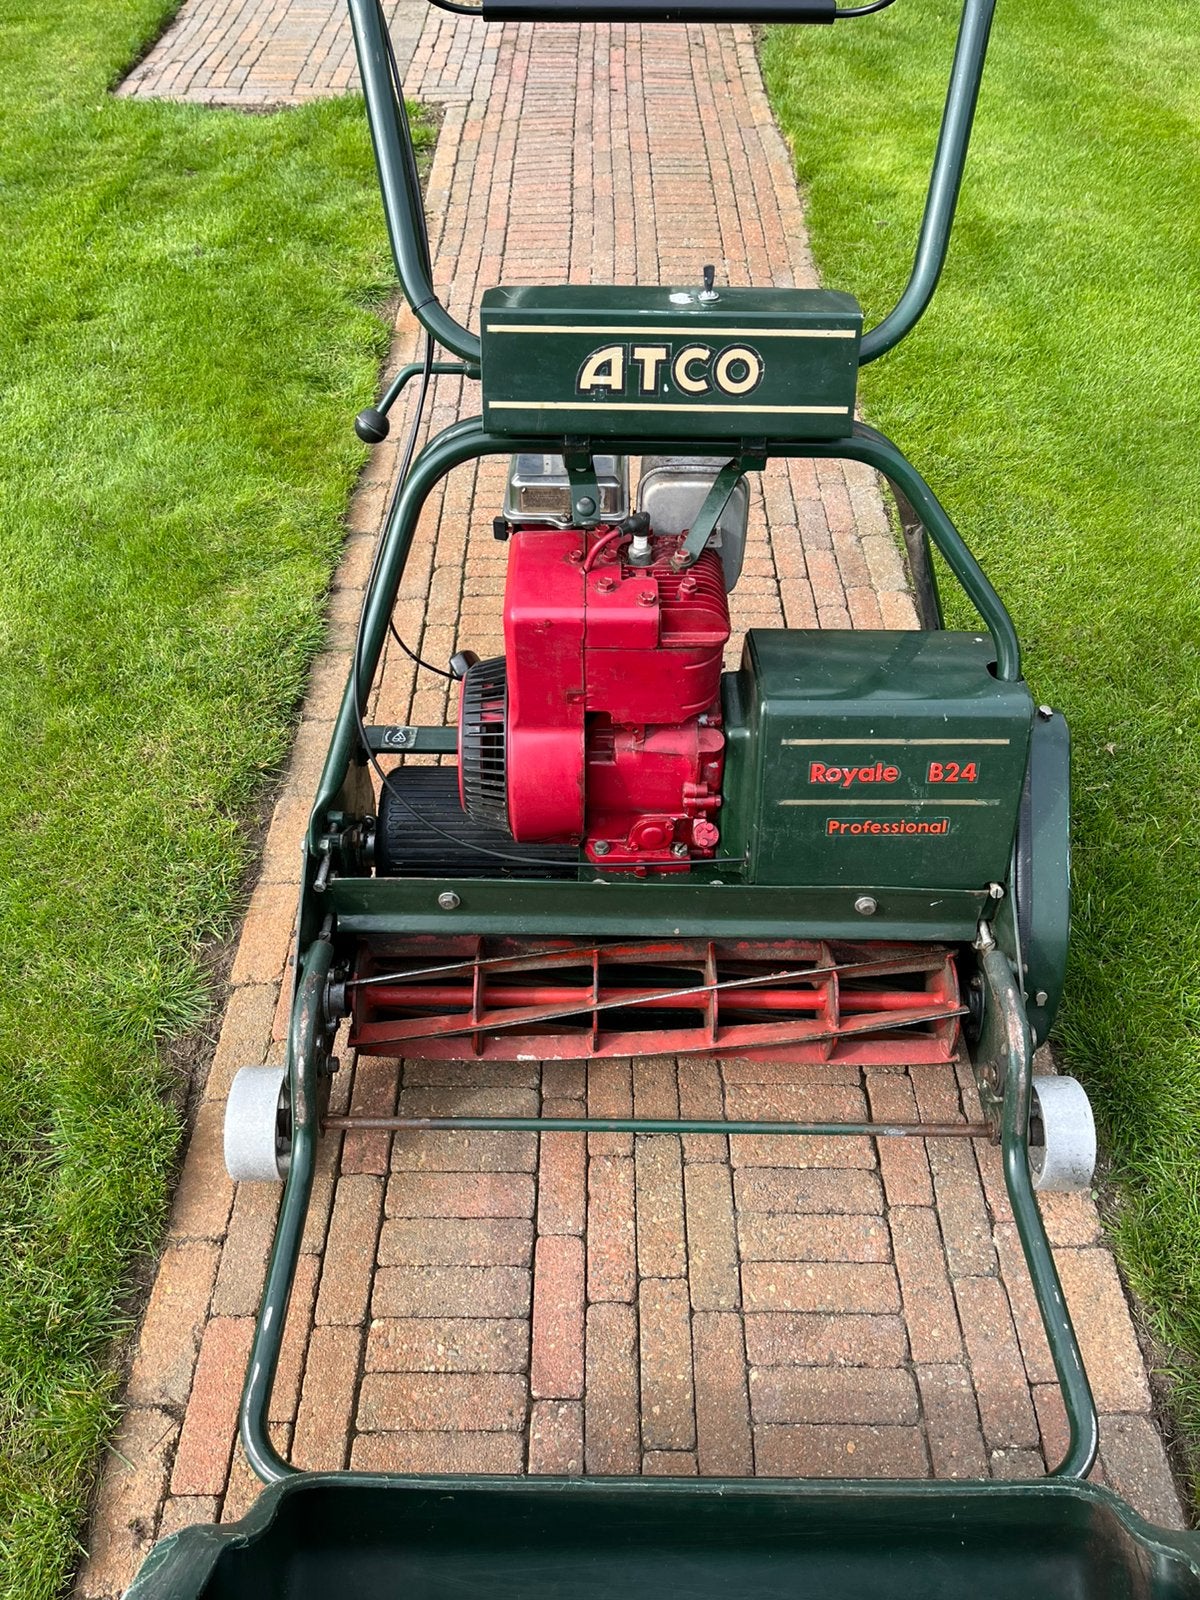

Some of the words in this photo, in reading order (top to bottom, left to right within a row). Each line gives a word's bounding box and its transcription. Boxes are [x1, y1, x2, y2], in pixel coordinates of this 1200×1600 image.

[578, 345, 762, 395] ATCO
[810, 762, 899, 788] Royale
[928, 762, 978, 782] B24
[828, 819, 948, 835] Professional
